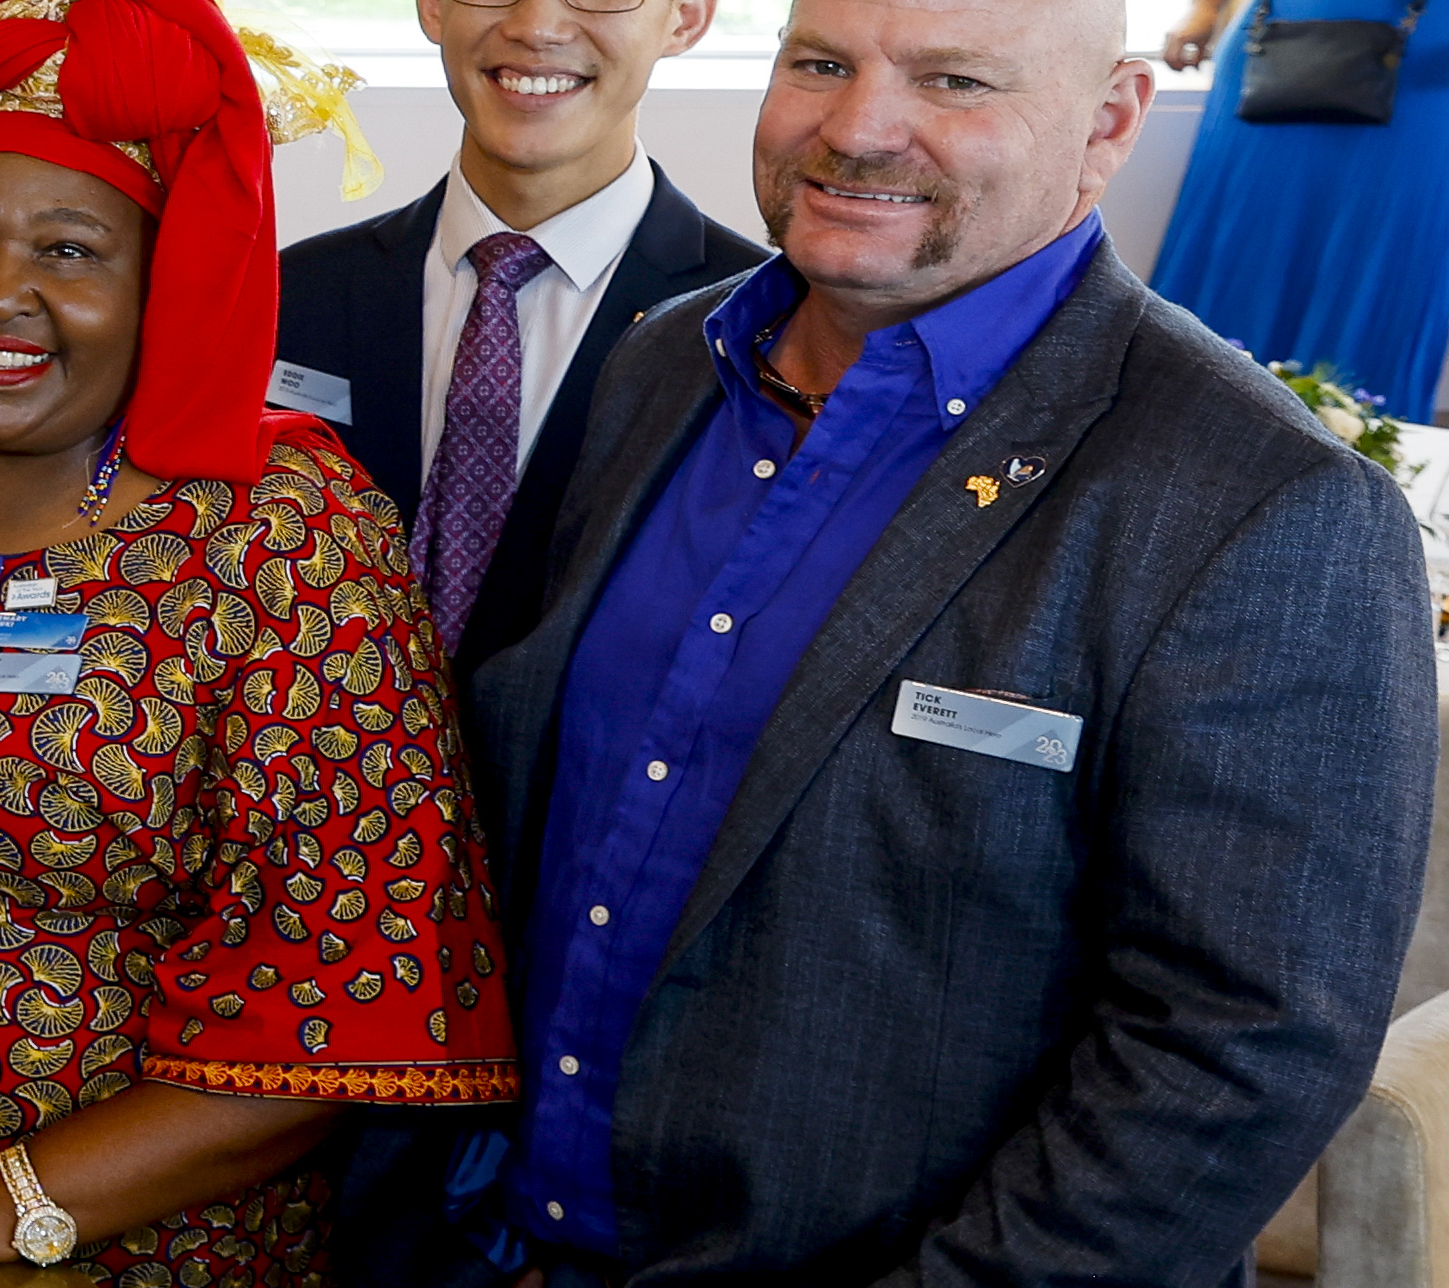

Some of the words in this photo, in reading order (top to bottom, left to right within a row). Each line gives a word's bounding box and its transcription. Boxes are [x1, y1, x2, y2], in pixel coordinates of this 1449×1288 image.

[16, 590, 51, 602] Awards
[915, 691, 942, 705] TICK
[912, 702, 958, 720] EVERETT
